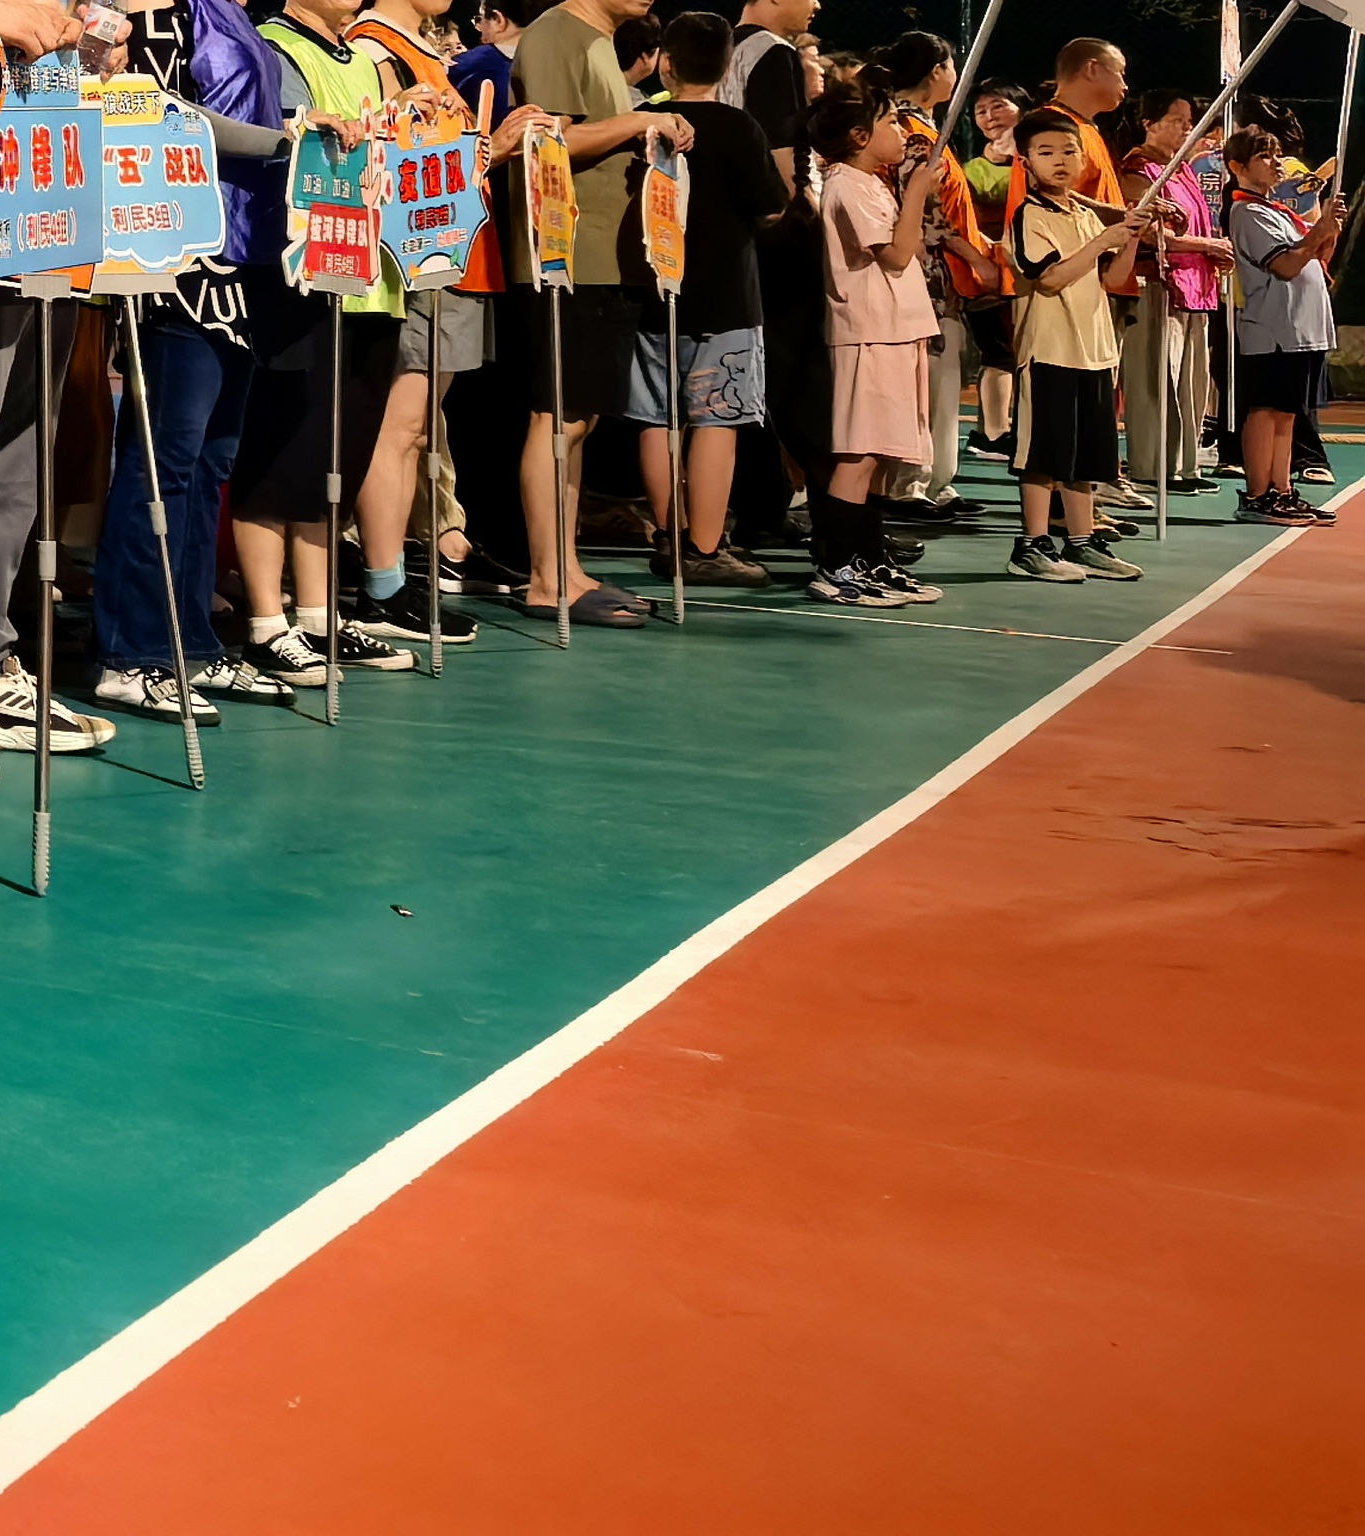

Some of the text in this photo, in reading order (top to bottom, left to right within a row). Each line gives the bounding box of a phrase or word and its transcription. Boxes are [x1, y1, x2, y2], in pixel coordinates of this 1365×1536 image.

[17, 207, 78, 252] （利民4组）
[102, 200, 184, 237] 利民5组）
